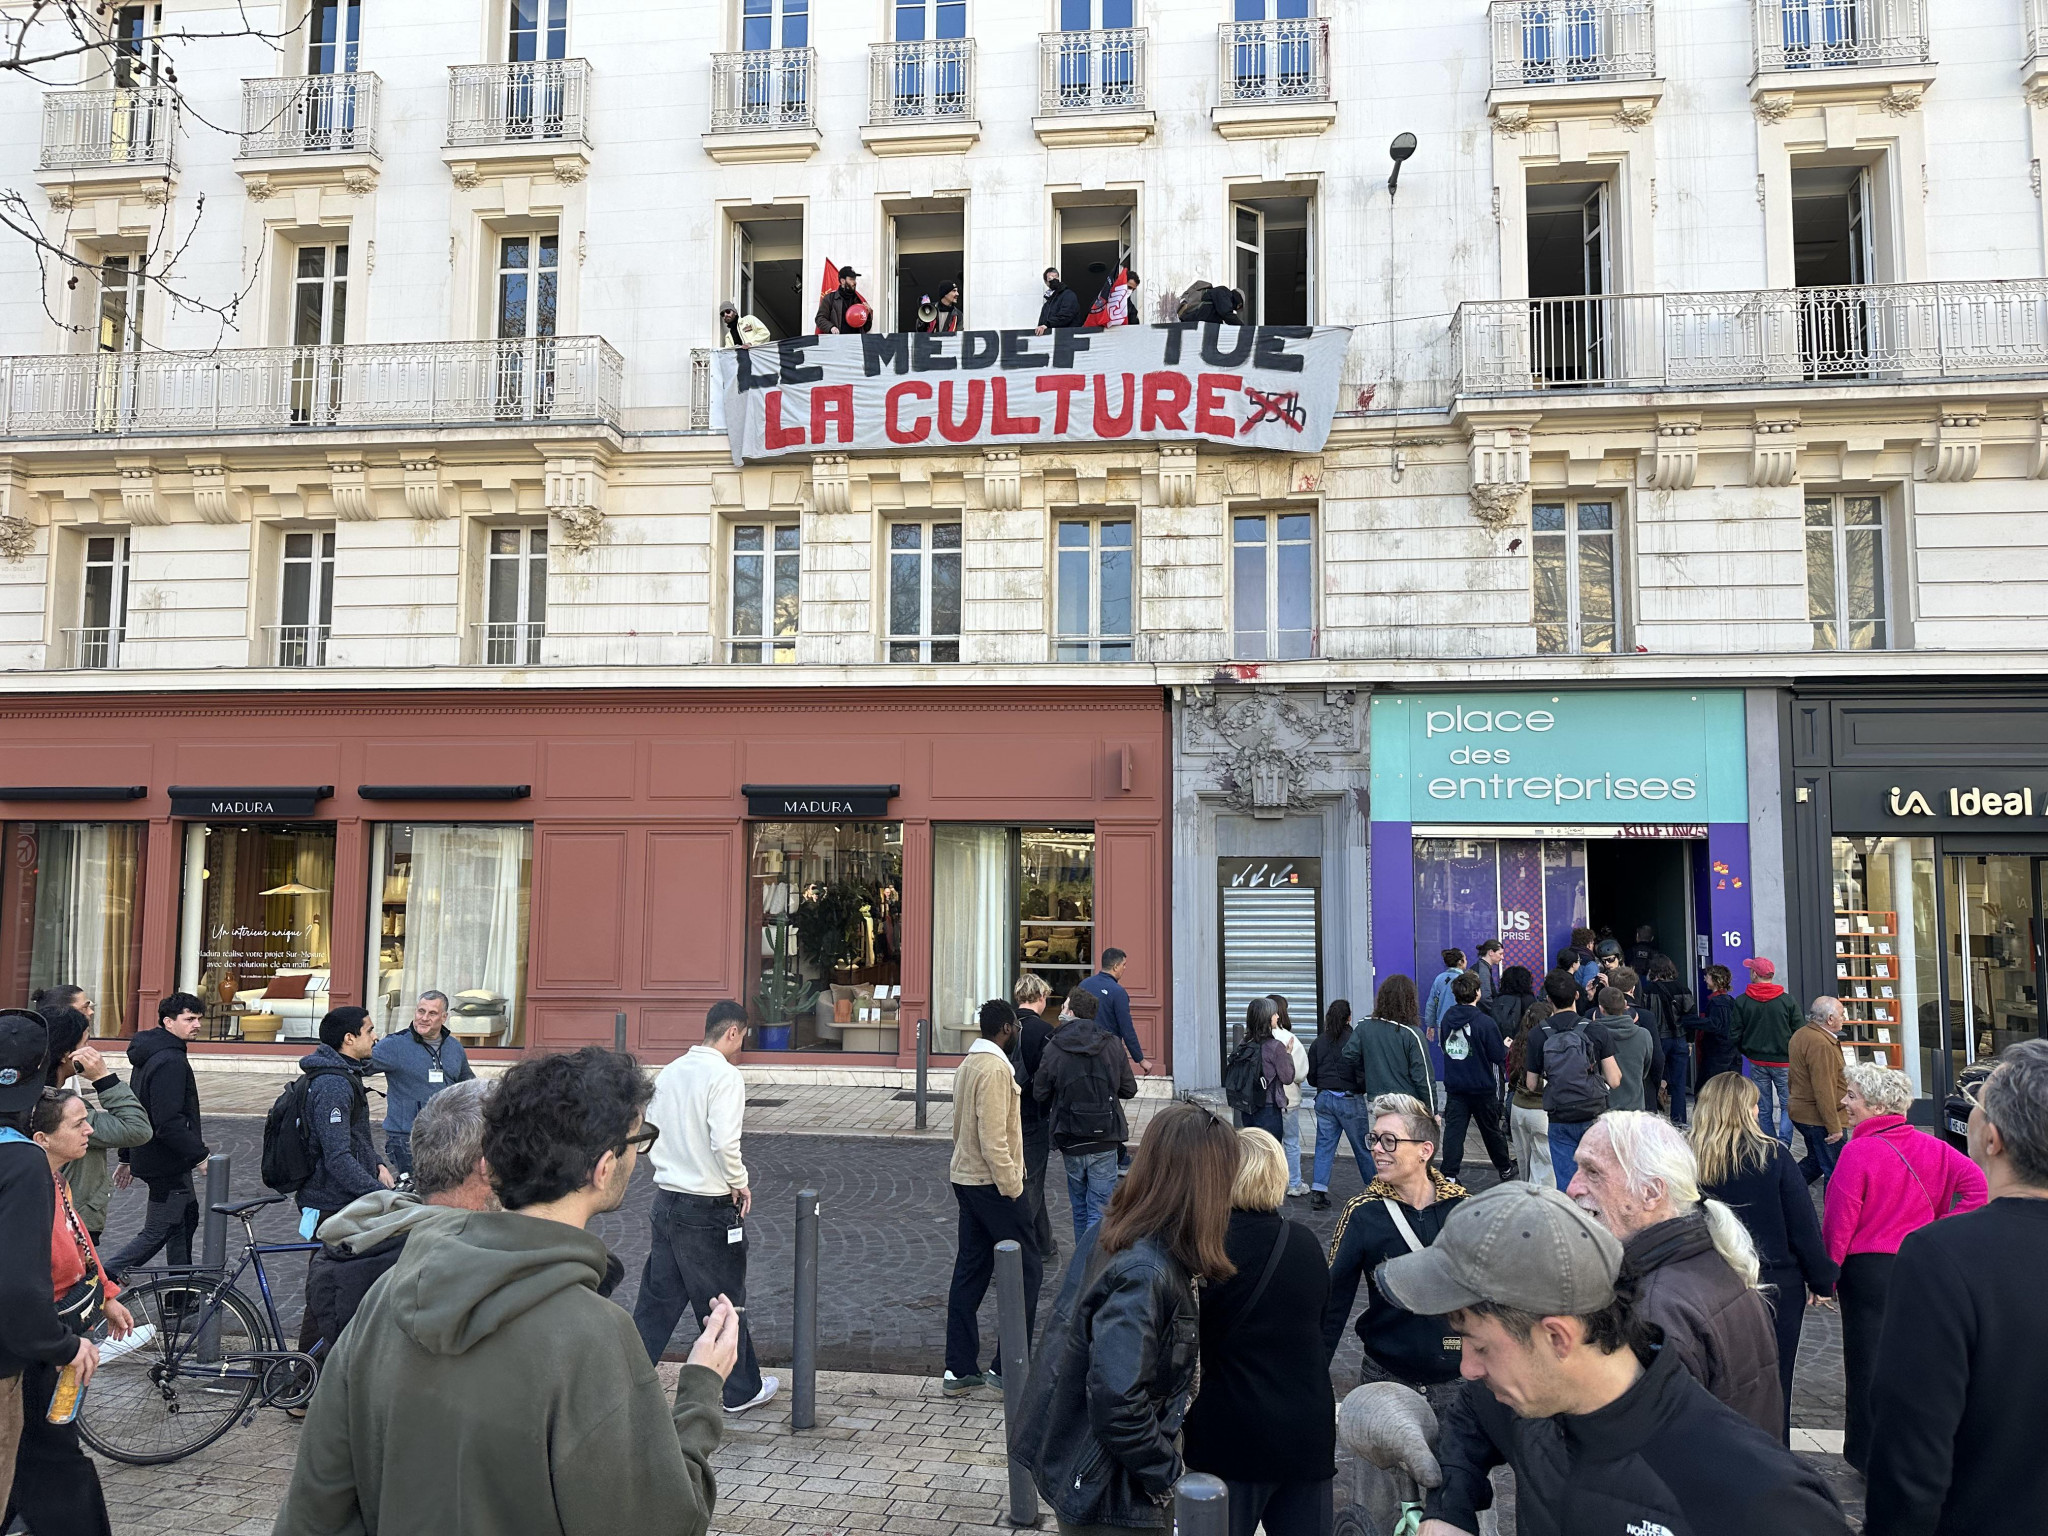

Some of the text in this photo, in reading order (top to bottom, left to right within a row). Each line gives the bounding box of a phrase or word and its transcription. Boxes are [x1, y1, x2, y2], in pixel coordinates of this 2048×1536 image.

[735, 321, 1313, 394] LE MEDEF TUE
[764, 384, 854, 450] LA
[885, 370, 1244, 444] CULTURE
[1426, 704, 1555, 738] place
[1449, 745, 1511, 765] des
[1427, 771, 1697, 805] entreprises
[211, 802, 274, 813] MADURA
[783, 801, 853, 813] MADURA
[1950, 787, 2033, 816] Ideal
[212, 923, 230, 940] Un
[271, 928, 303, 943] unique
[304, 924, 313, 940] ?
[1721, 931, 1742, 947] 16
[223, 960, 237, 968] des
[237, 960, 268, 968] solutions
[264, 950, 284, 960] projet
[1641, 1519, 1661, 1534] THE
